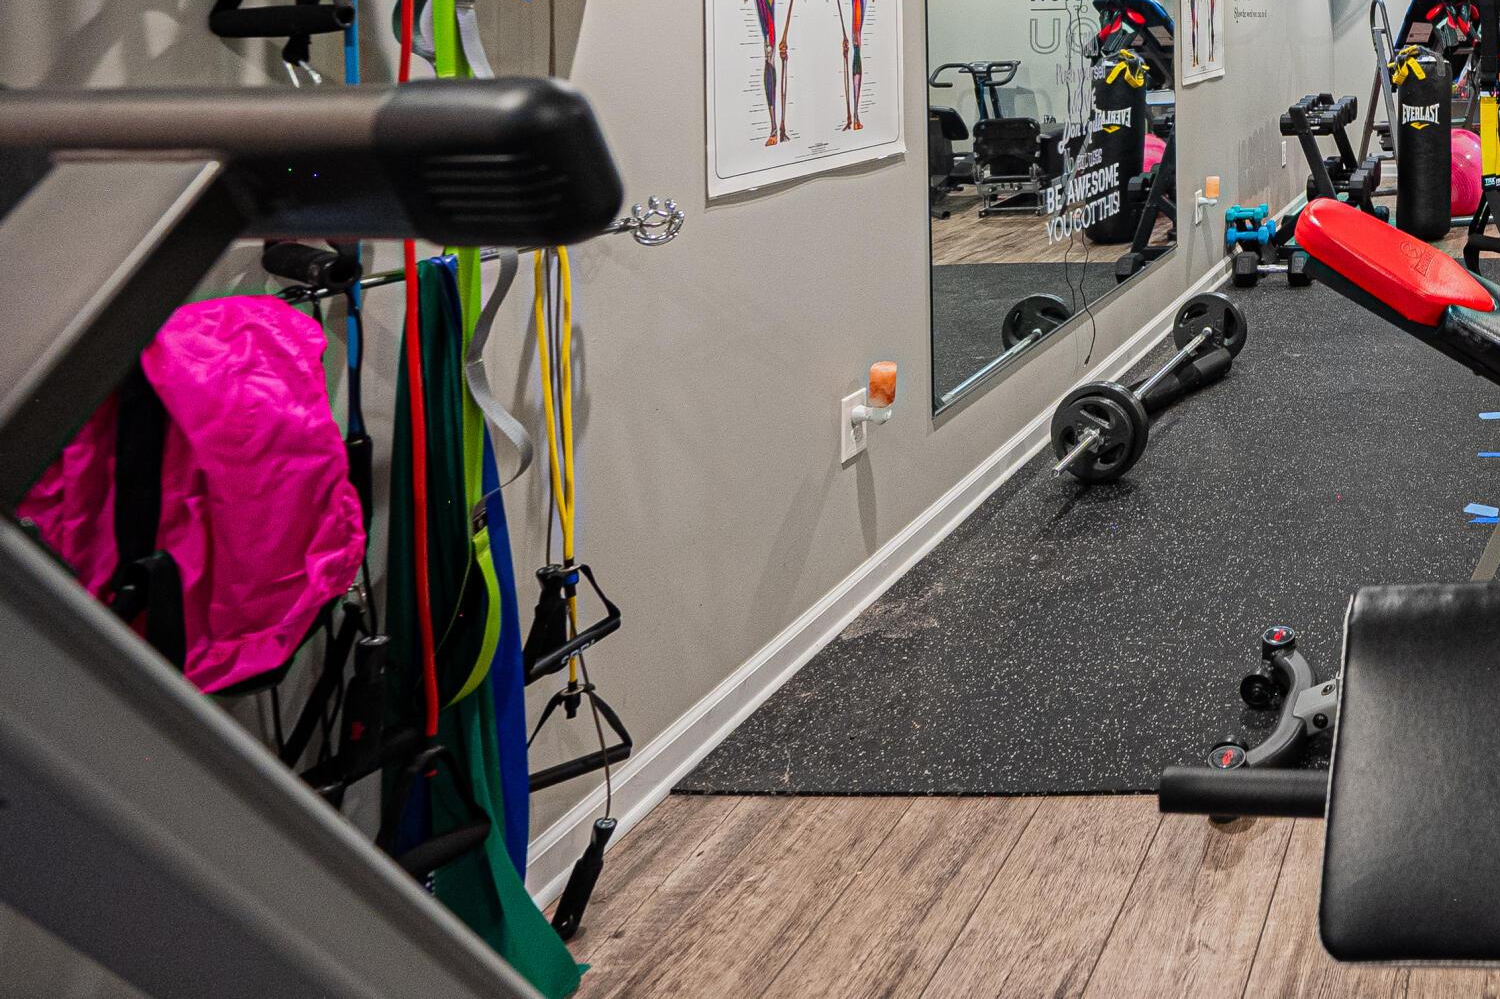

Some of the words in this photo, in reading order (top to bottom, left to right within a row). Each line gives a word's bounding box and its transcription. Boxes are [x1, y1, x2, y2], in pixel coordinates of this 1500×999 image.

[1402, 103, 1440, 125] EVERLAST
[1047, 184, 1063, 214] BE
[1066, 162, 1120, 205] AWESOME
[1046, 211, 1073, 245] YOU
[1097, 190, 1121, 221] THIS!
